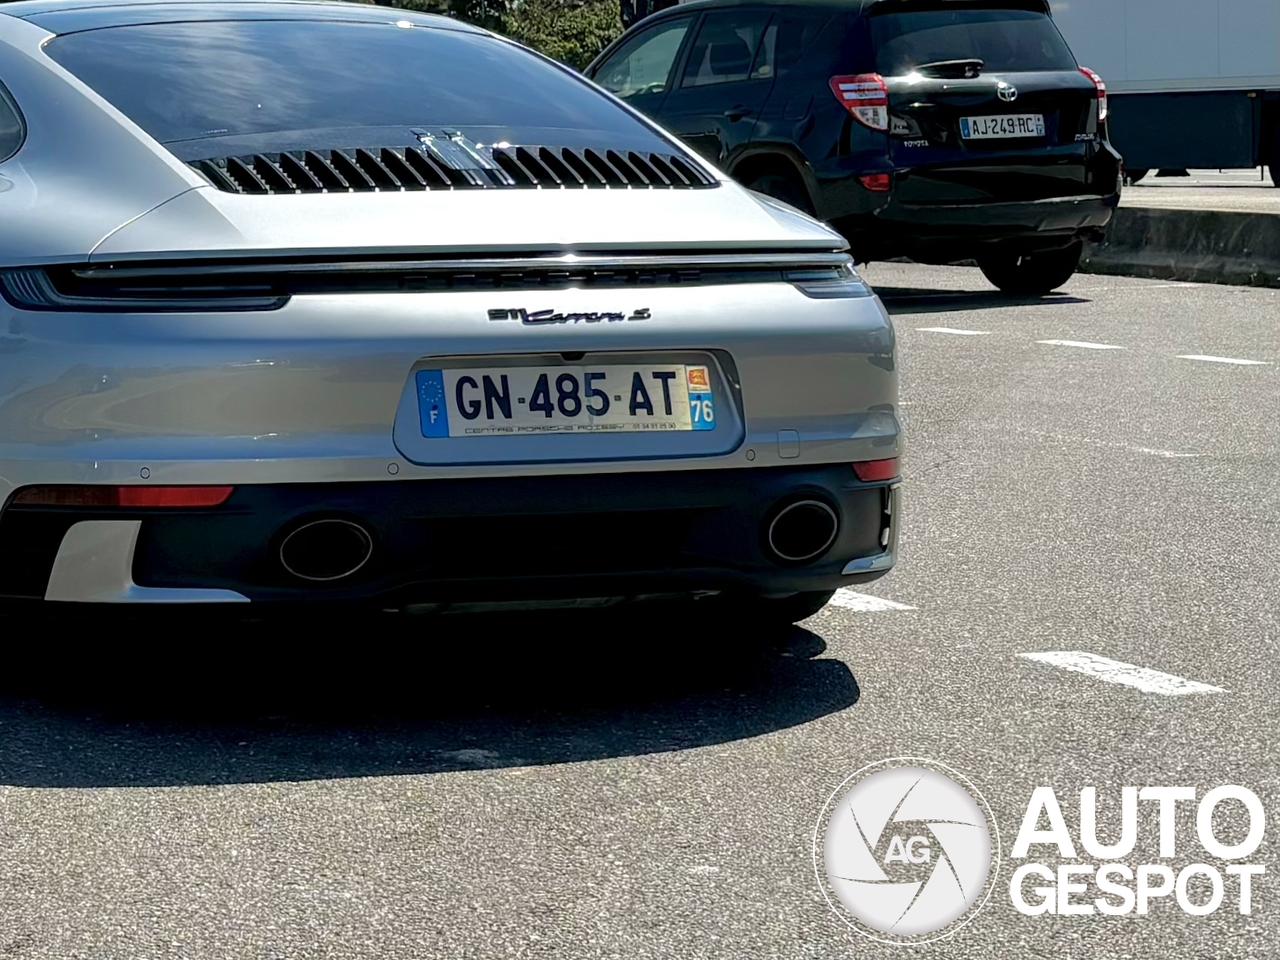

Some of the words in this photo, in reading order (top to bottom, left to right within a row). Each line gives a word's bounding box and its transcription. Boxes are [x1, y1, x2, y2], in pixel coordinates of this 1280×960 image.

[972, 117, 1034, 136] AJ-249-RC
[522, 308, 625, 326] Carrera
[628, 307, 651, 321] S
[455, 371, 677, 420] GN-485-AT
[429, 410, 438, 424] F
[690, 400, 714, 422] 76
[517, 422, 573, 432] PORSCHE
